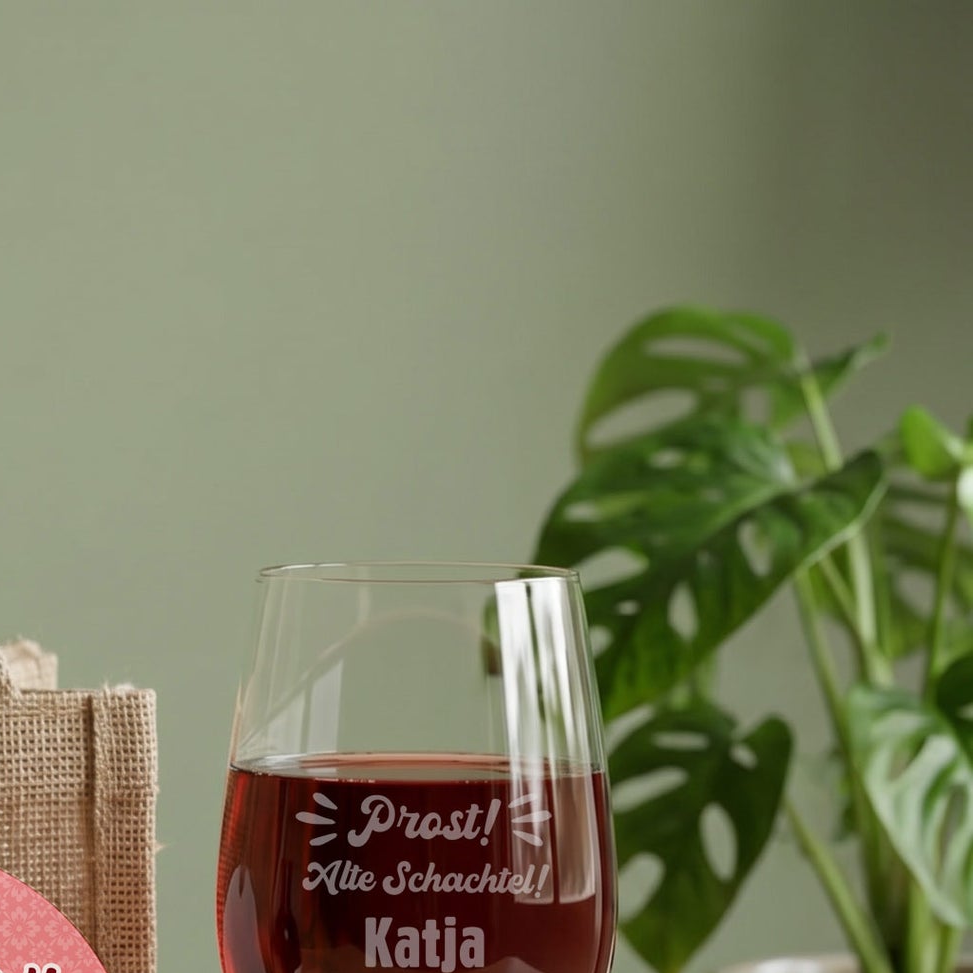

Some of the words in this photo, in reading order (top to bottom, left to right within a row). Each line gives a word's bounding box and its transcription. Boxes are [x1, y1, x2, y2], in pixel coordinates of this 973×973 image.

[347, 794, 502, 847] Prost!
[302, 860, 376, 895] Alte
[382, 861, 550, 898] Schachtel!
[365, 916, 485, 973] Katja
